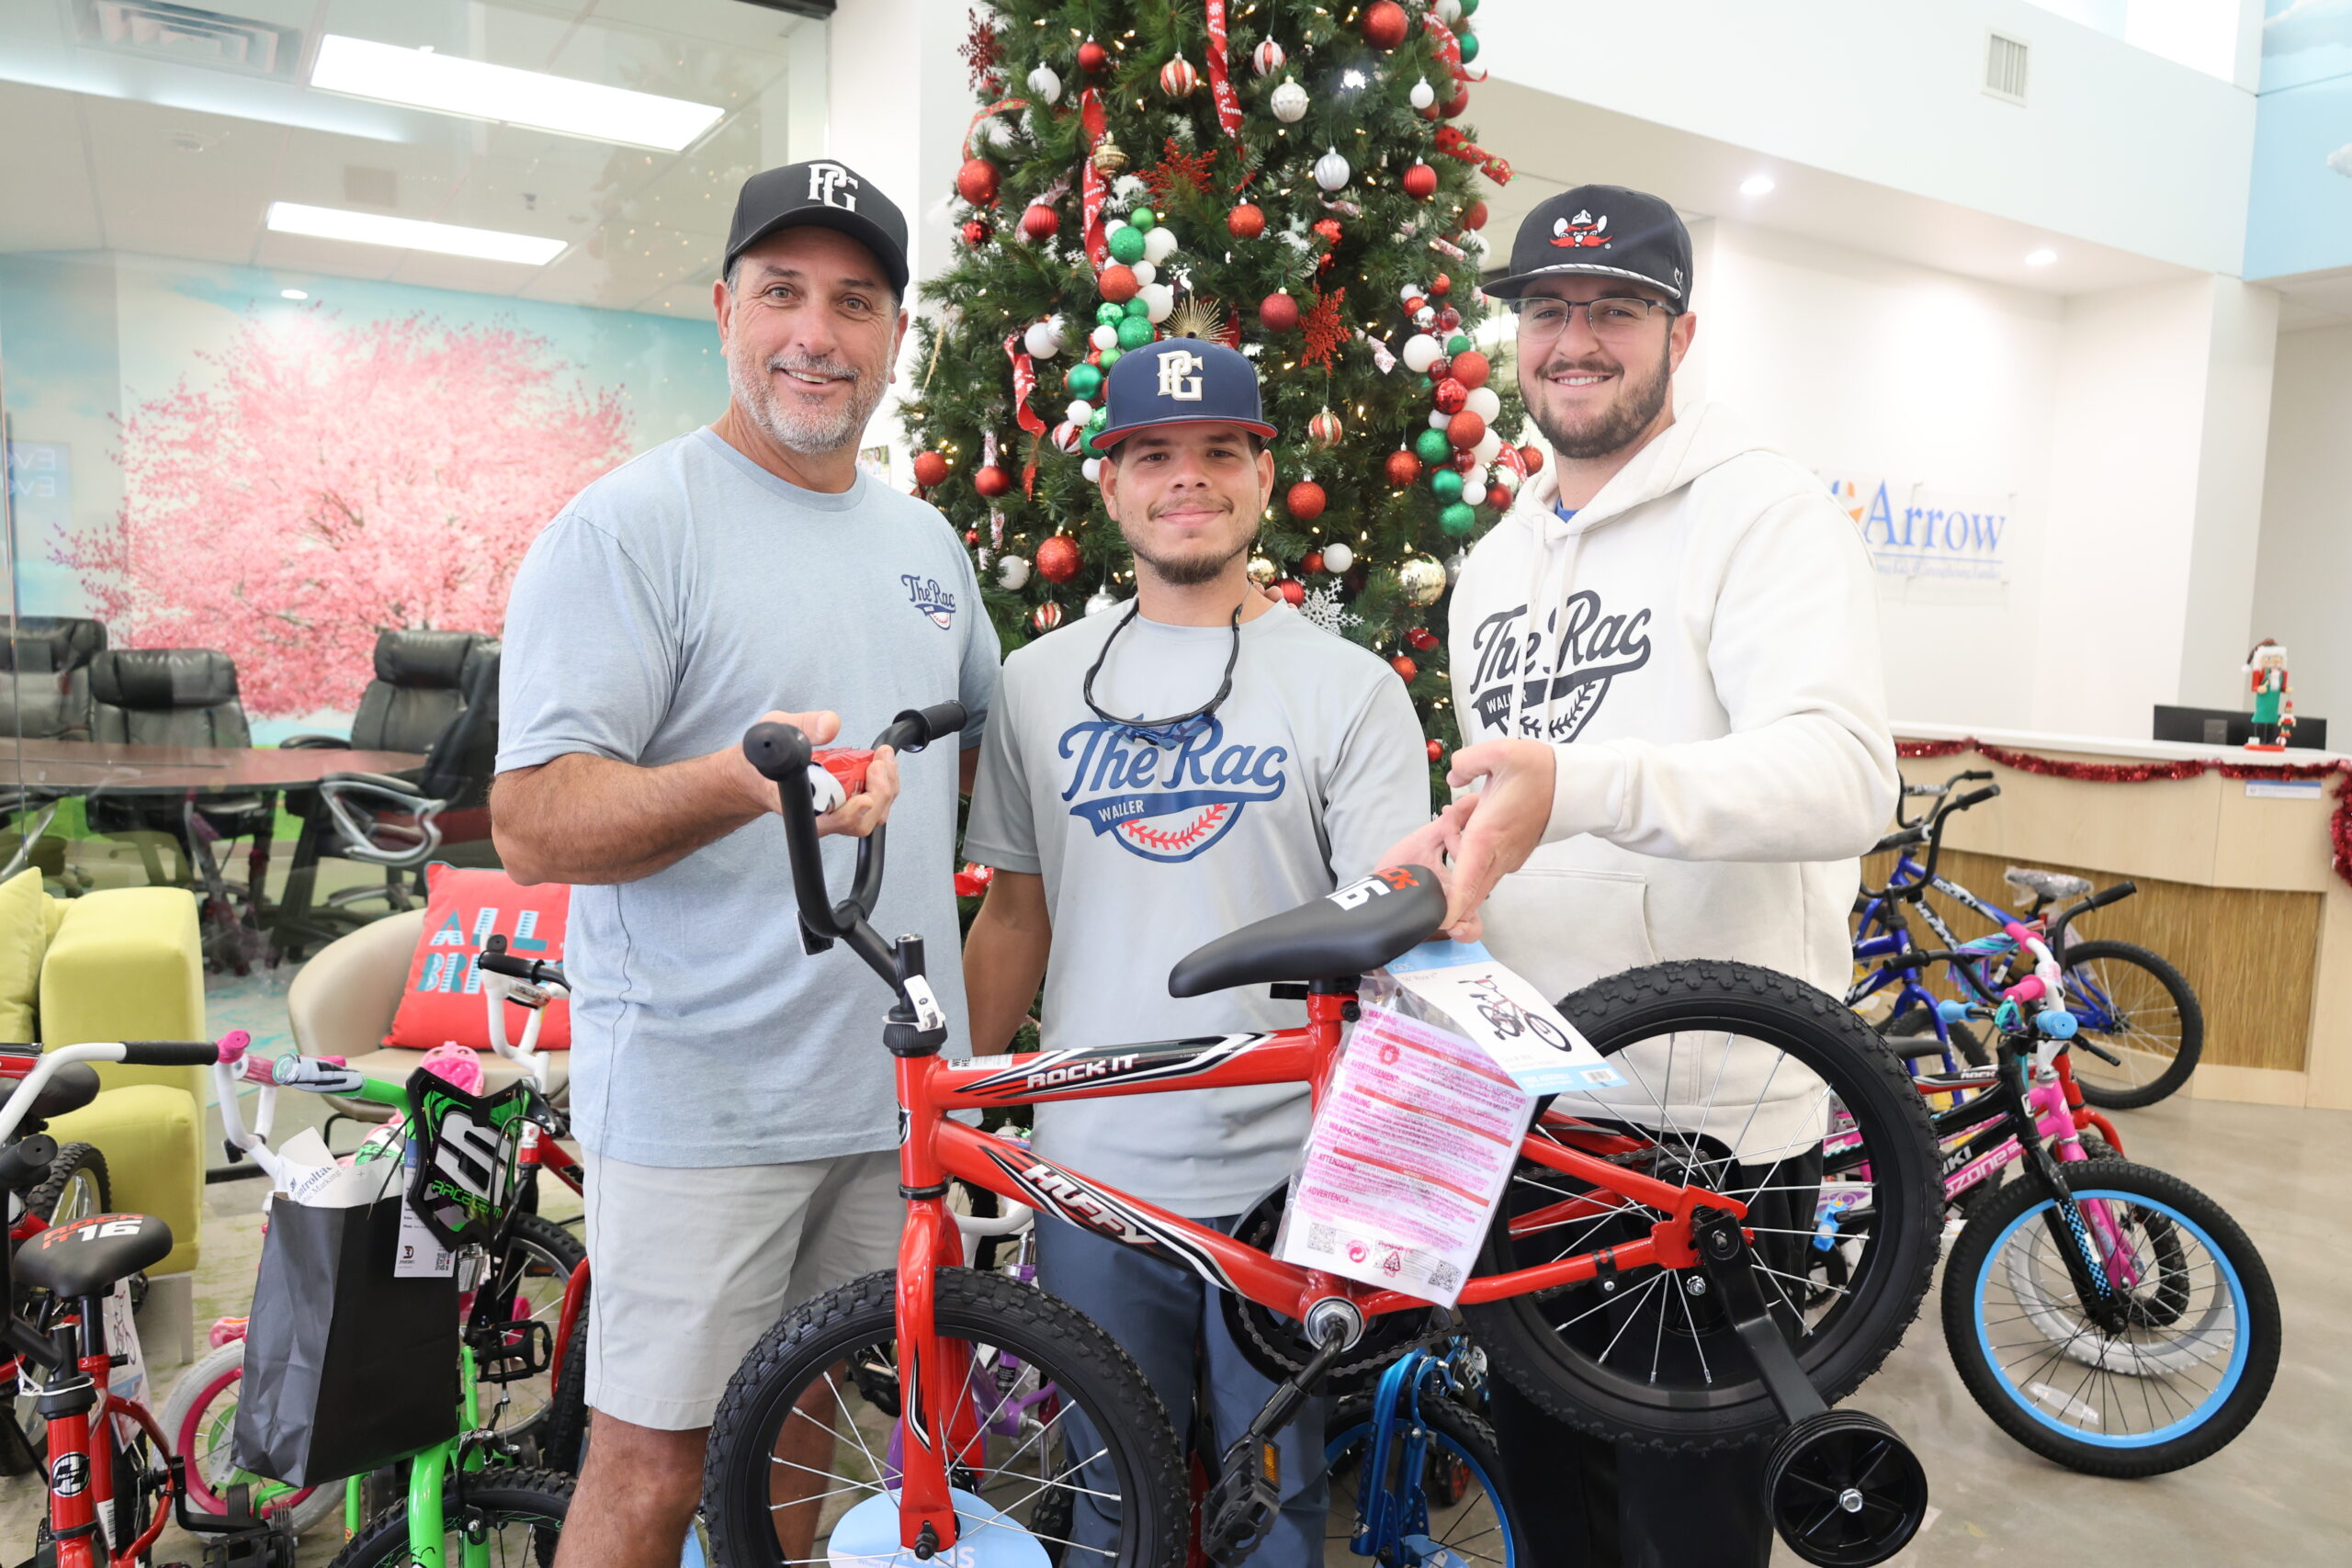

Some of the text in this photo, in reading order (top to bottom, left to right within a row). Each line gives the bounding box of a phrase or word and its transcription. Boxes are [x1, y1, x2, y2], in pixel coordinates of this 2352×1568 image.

[1157, 350, 1203, 400] PG
[1864, 479, 2007, 552] Arrow
[901, 574, 956, 607] The Rac
[1470, 590, 1652, 694] The Rac
[1058, 714, 1287, 801] The Rac
[1097, 799, 1145, 822] WALLER
[429, 907, 548, 952] ALL
[1026, 1054, 1139, 1089] ROCK IT
[44, 1213, 144, 1239] ROCK
[1022, 1164, 1157, 1246] HUFFY
[77, 1220, 142, 1242] 16
